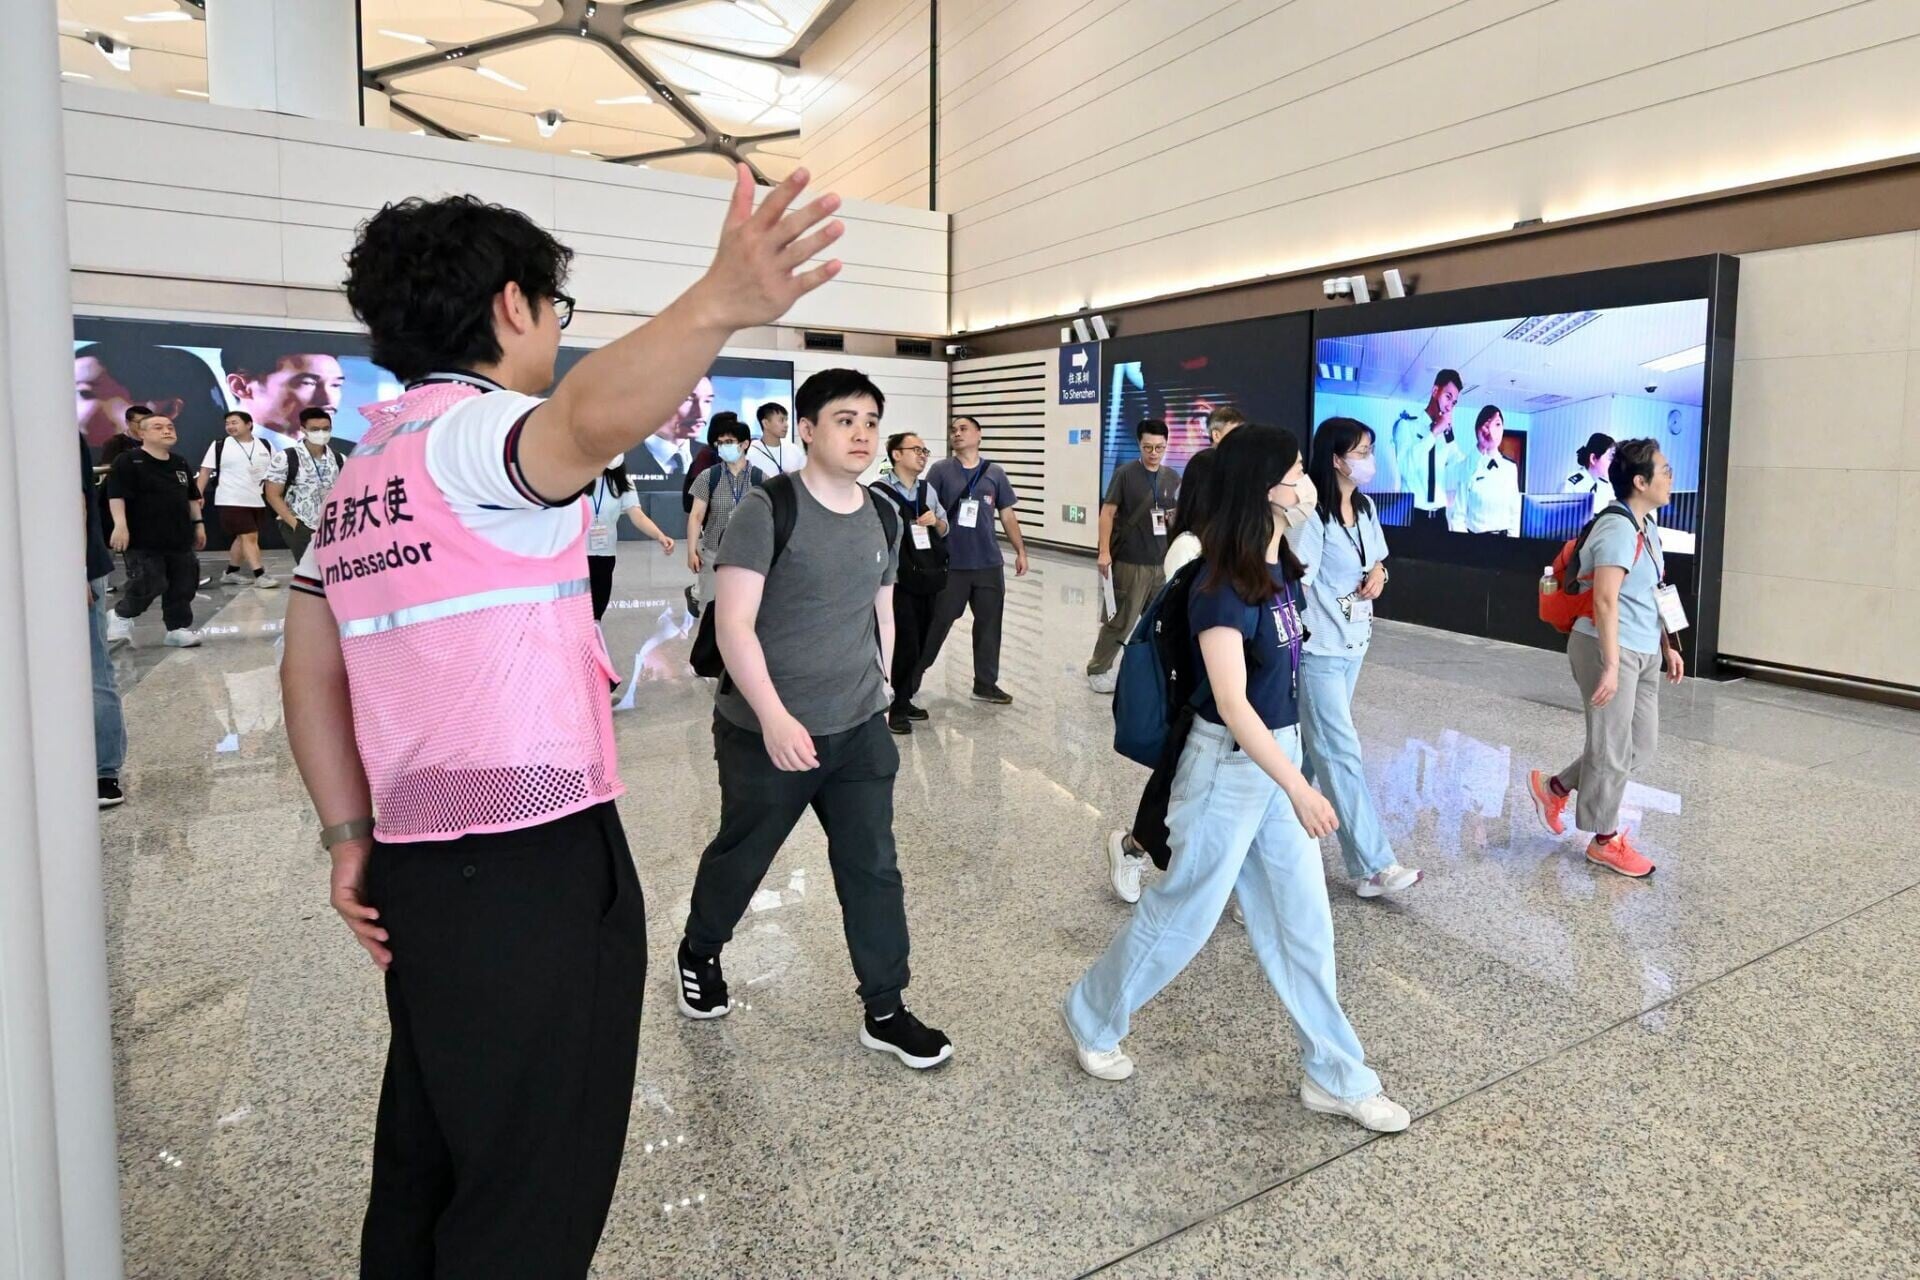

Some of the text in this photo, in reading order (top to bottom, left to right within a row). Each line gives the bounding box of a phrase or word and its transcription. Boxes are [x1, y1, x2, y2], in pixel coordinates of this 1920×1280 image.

[1068, 370, 1090, 385] 往深圳
[1062, 387, 1096, 400] To Shenzhen
[314, 475, 414, 550] 服務大使
